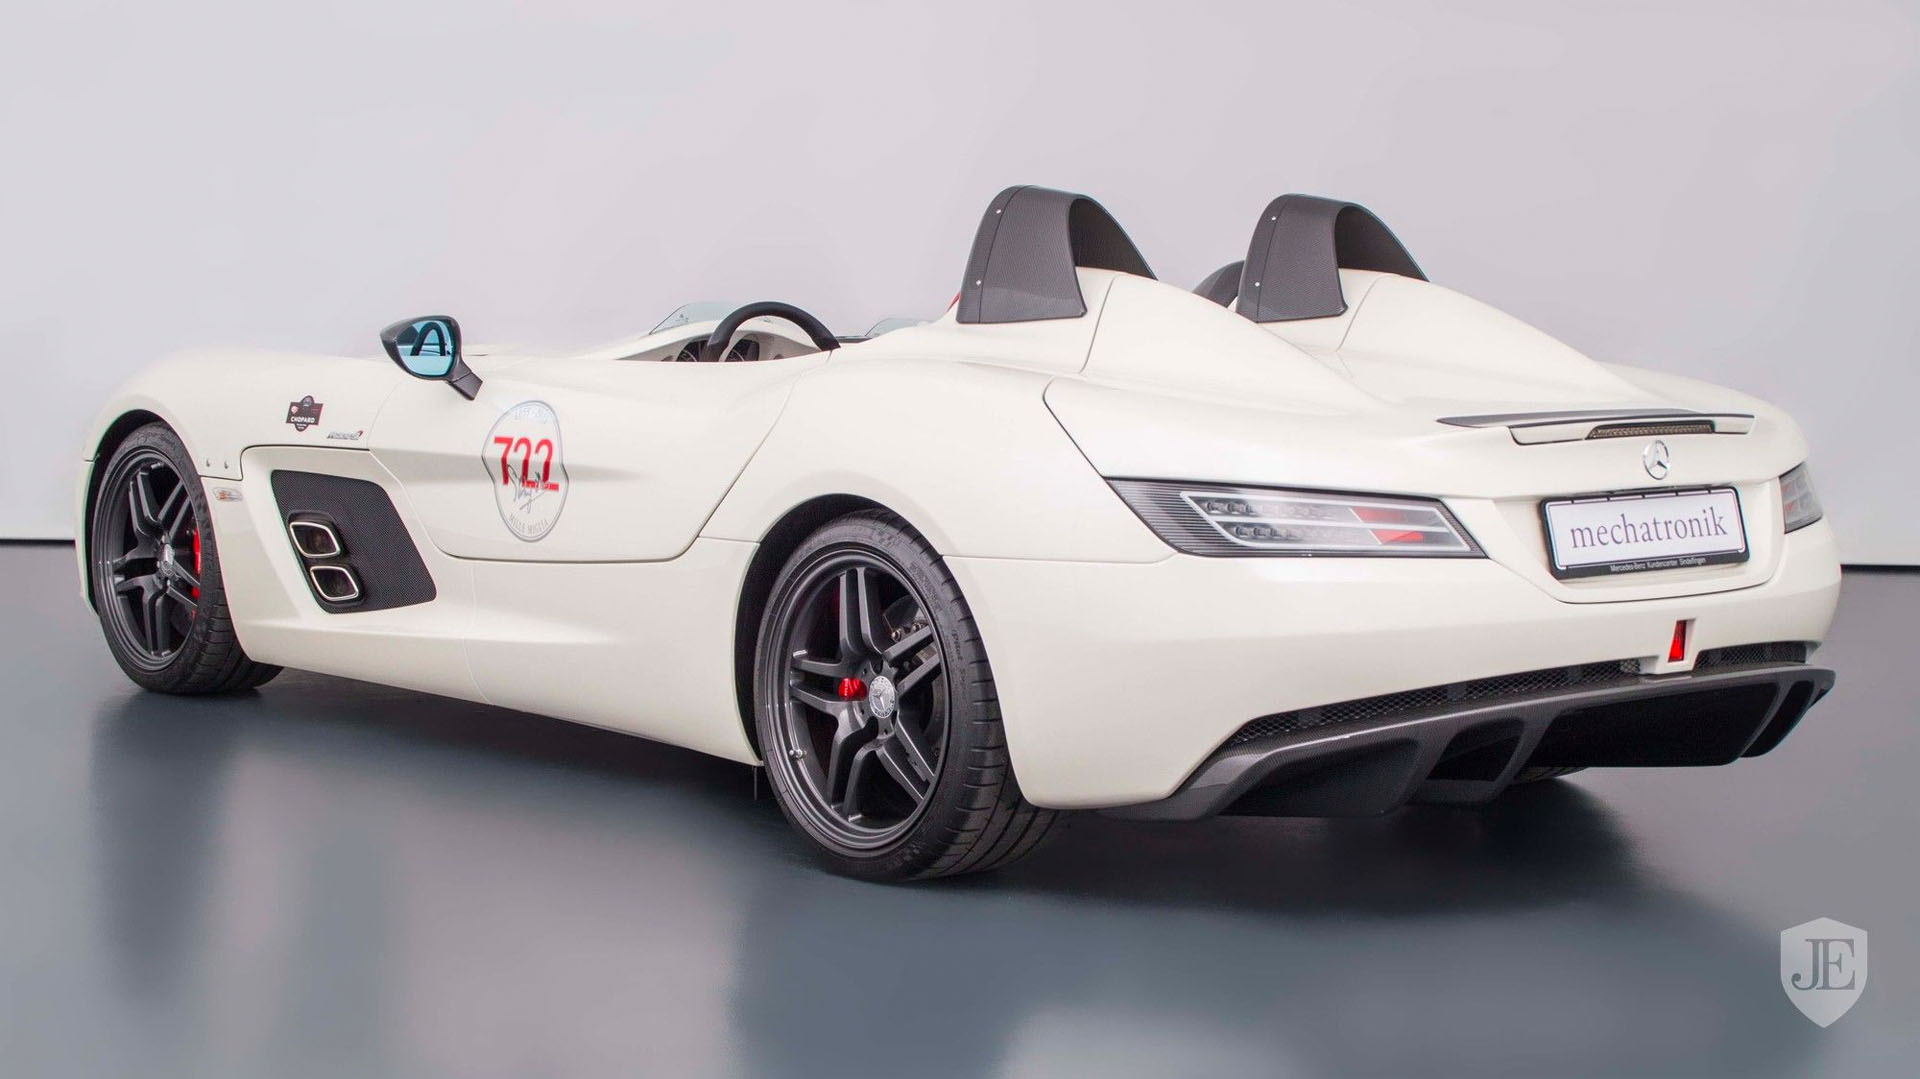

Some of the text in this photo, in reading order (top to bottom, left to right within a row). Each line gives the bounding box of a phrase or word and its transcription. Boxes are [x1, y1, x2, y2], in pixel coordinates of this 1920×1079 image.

[494, 436, 559, 491] 722
[1570, 506, 1728, 549] mechatronik
[1610, 562, 1646, 572] Mercedes-Benz
